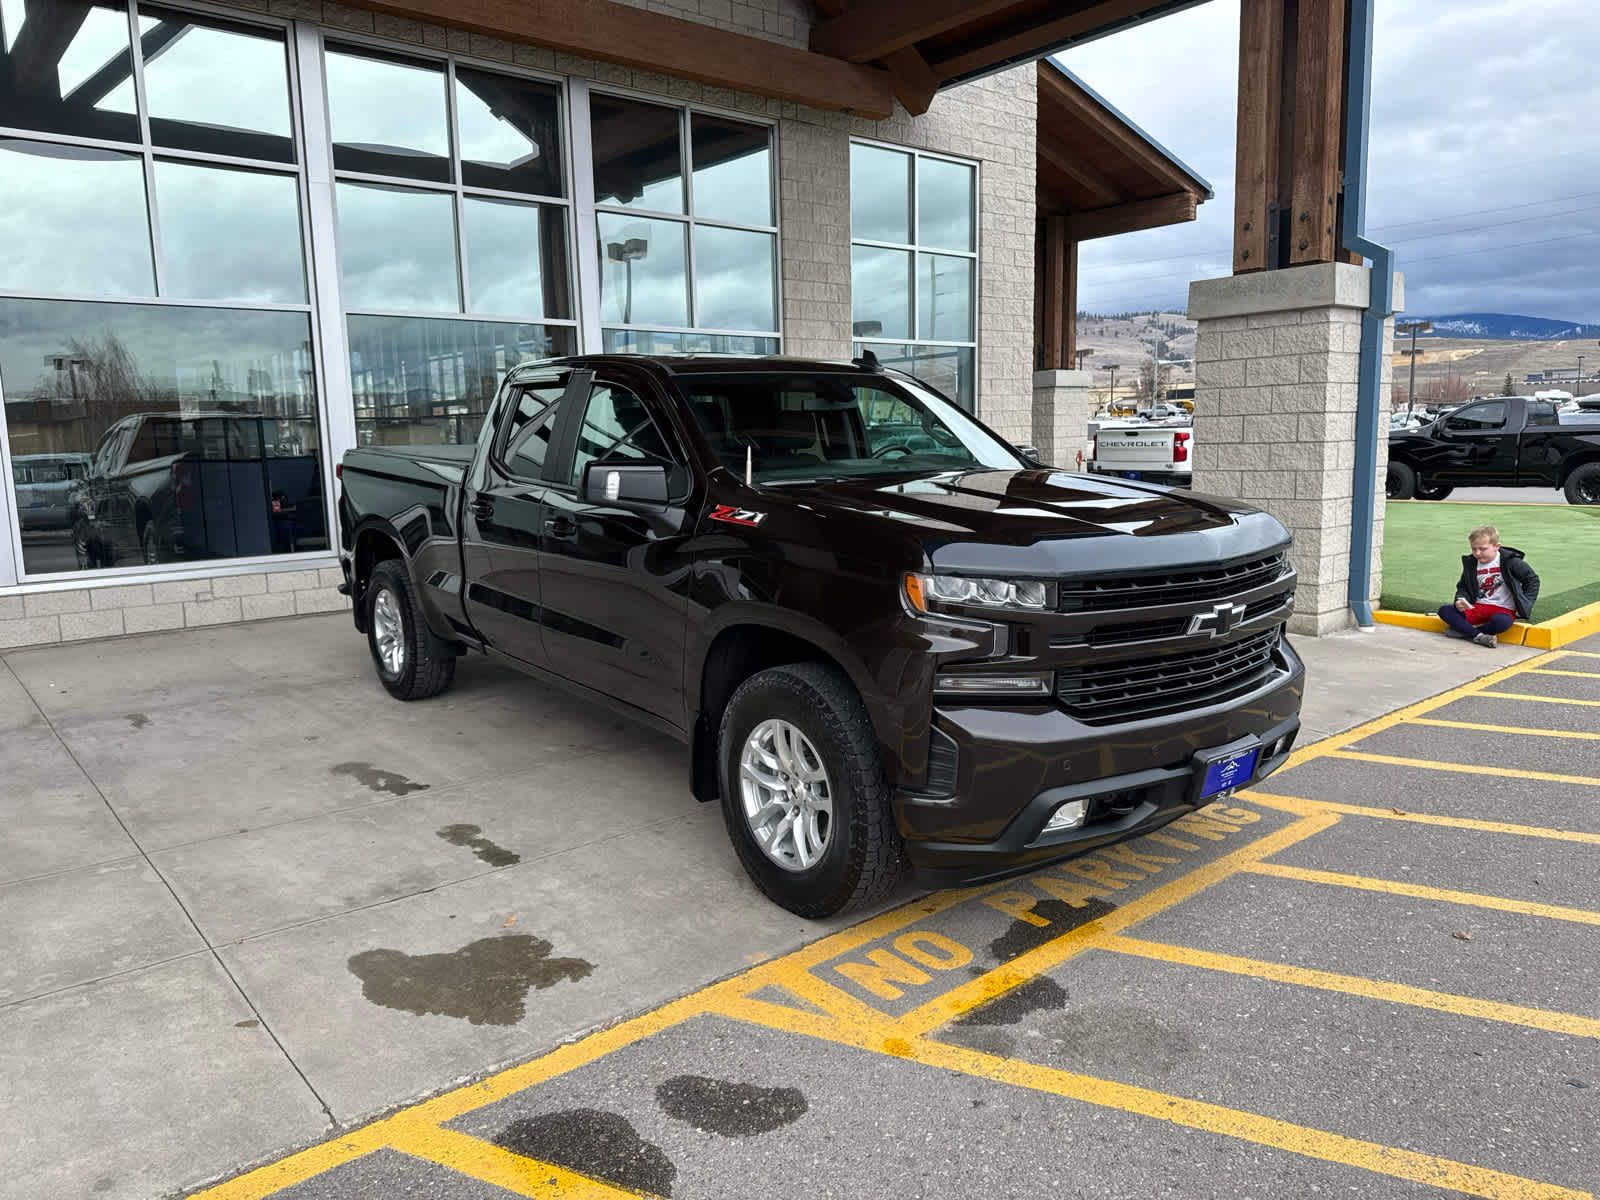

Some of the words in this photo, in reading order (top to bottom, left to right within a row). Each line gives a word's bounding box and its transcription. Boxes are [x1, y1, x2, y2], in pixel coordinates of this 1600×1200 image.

[1100, 440, 1168, 448] CHEVROLET
[709, 504, 768, 527] Z71
[833, 930, 973, 1001] NO
[980, 802, 1261, 928] PARKING
